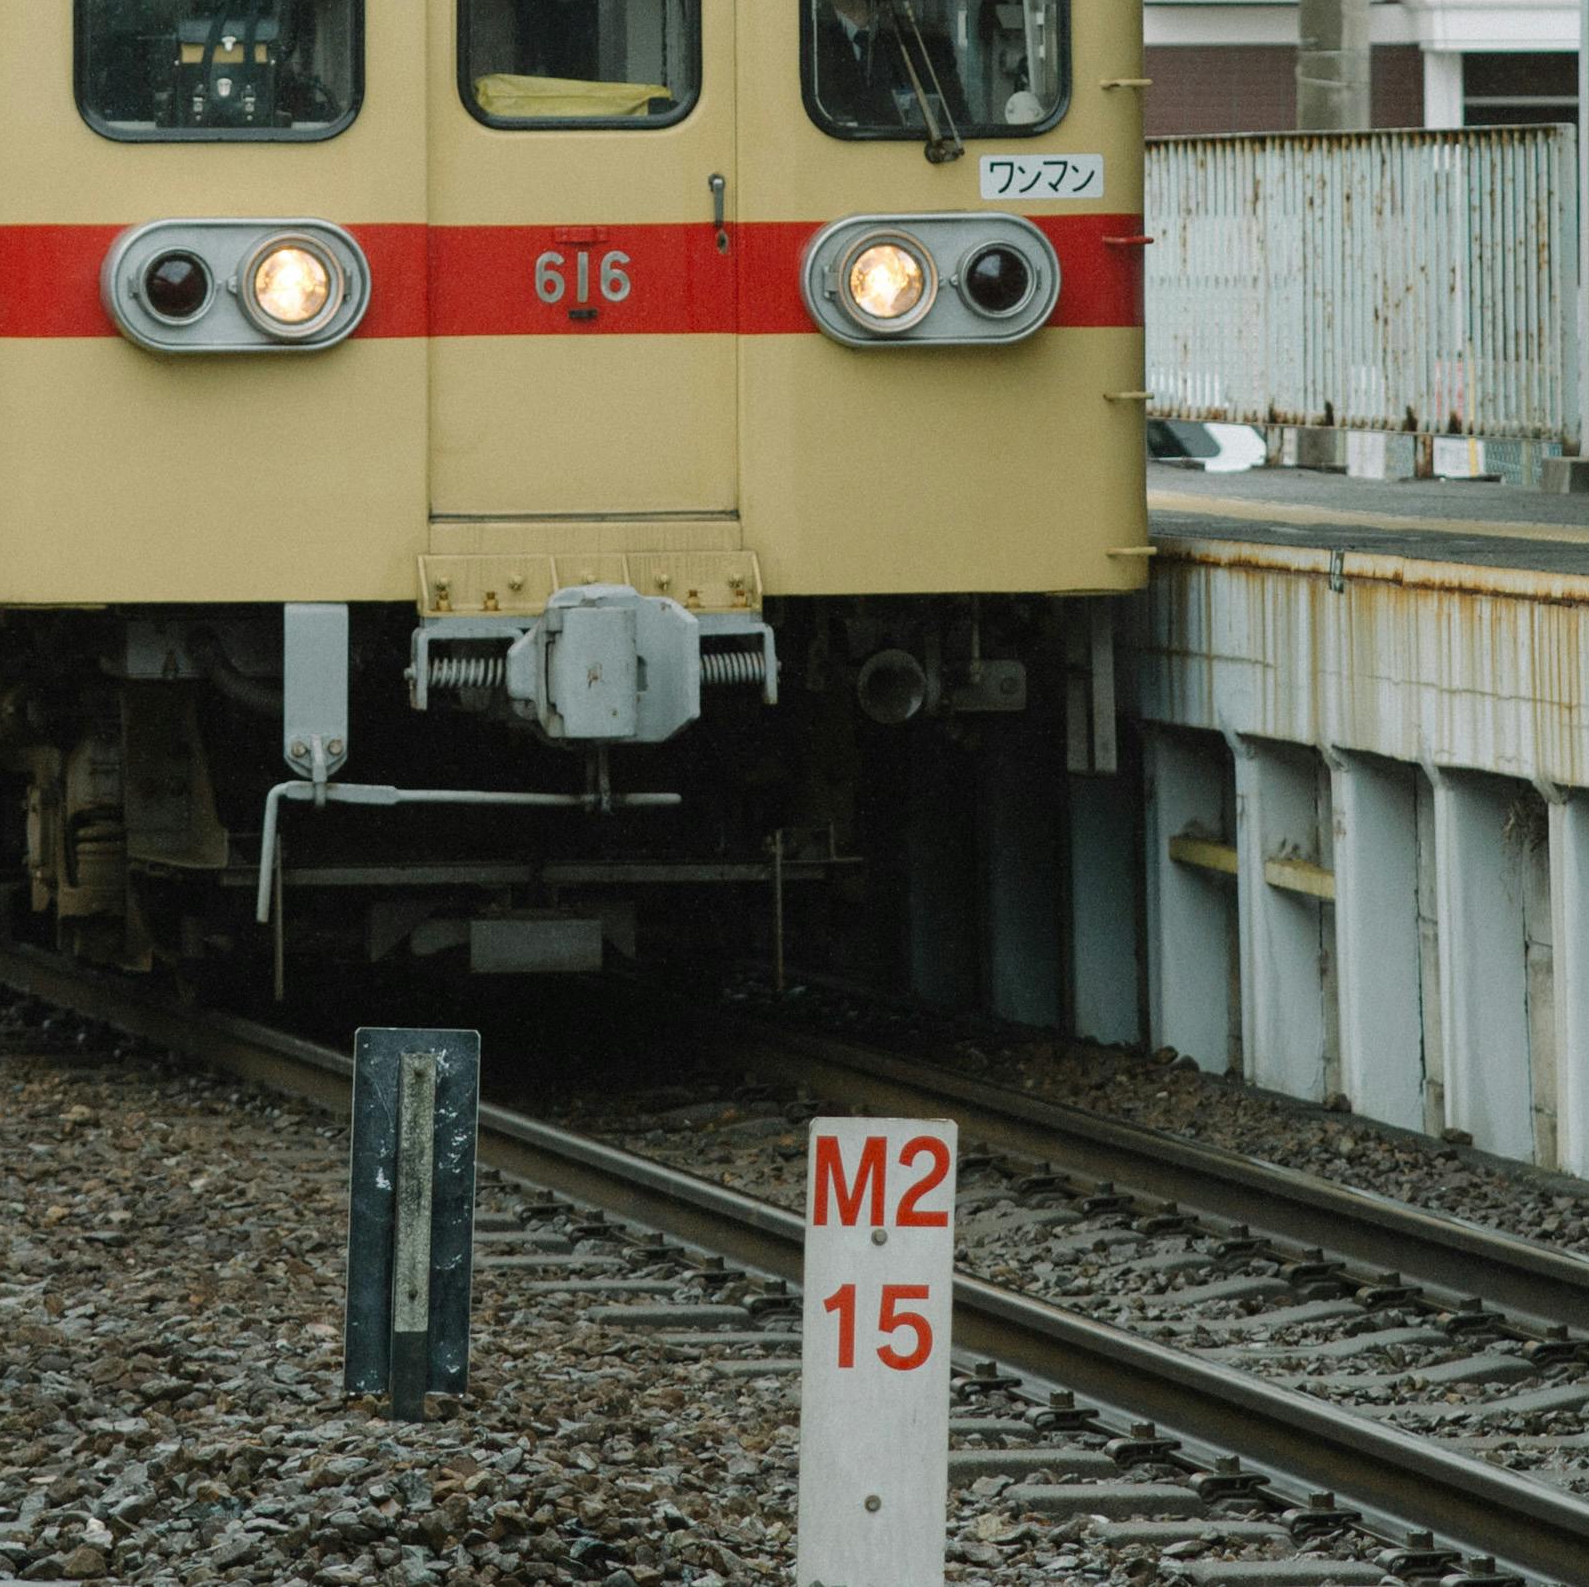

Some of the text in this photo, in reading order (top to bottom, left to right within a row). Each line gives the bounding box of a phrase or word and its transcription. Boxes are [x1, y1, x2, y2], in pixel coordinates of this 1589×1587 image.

[990, 161, 1095, 193] ワンマン
[535, 250, 631, 303] 616
[813, 1136, 950, 1227] M2
[823, 1283, 933, 1371] 15
